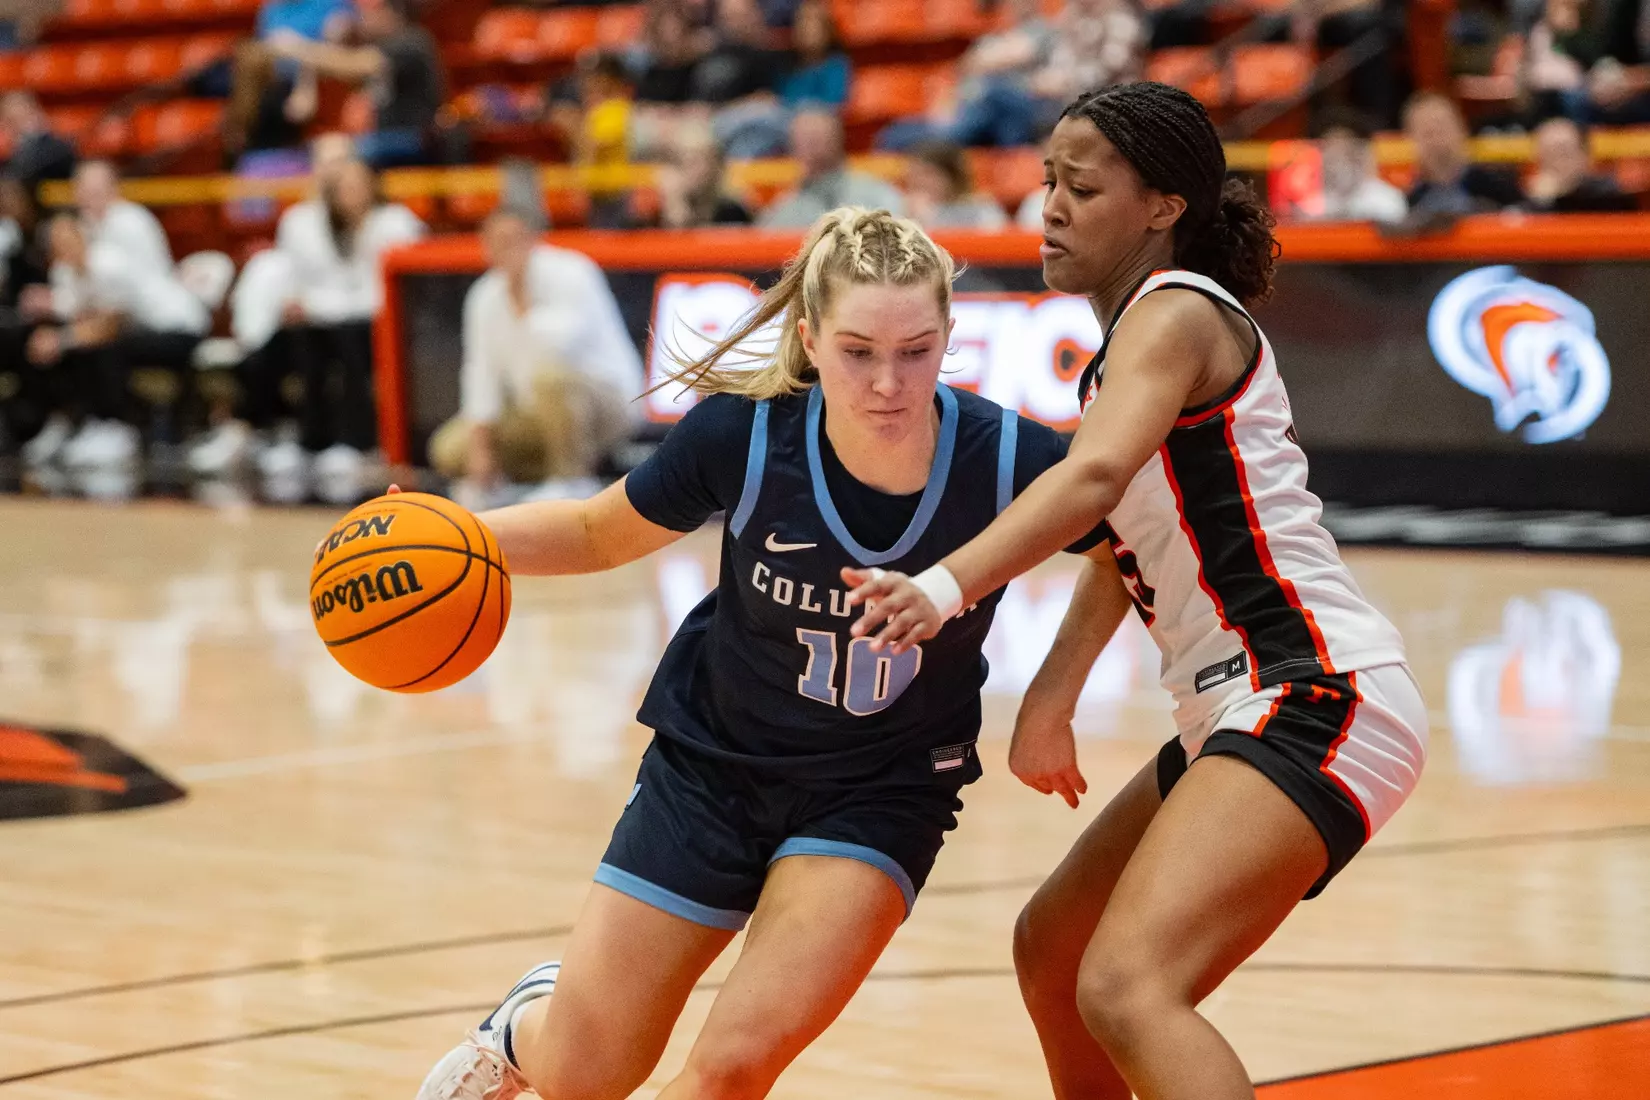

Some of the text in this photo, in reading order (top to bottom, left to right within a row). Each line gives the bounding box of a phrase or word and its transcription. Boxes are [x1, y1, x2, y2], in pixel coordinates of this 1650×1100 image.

[311, 559, 424, 622] Wilson
[796, 627, 923, 717] 10
[1231, 659, 1241, 673] M
